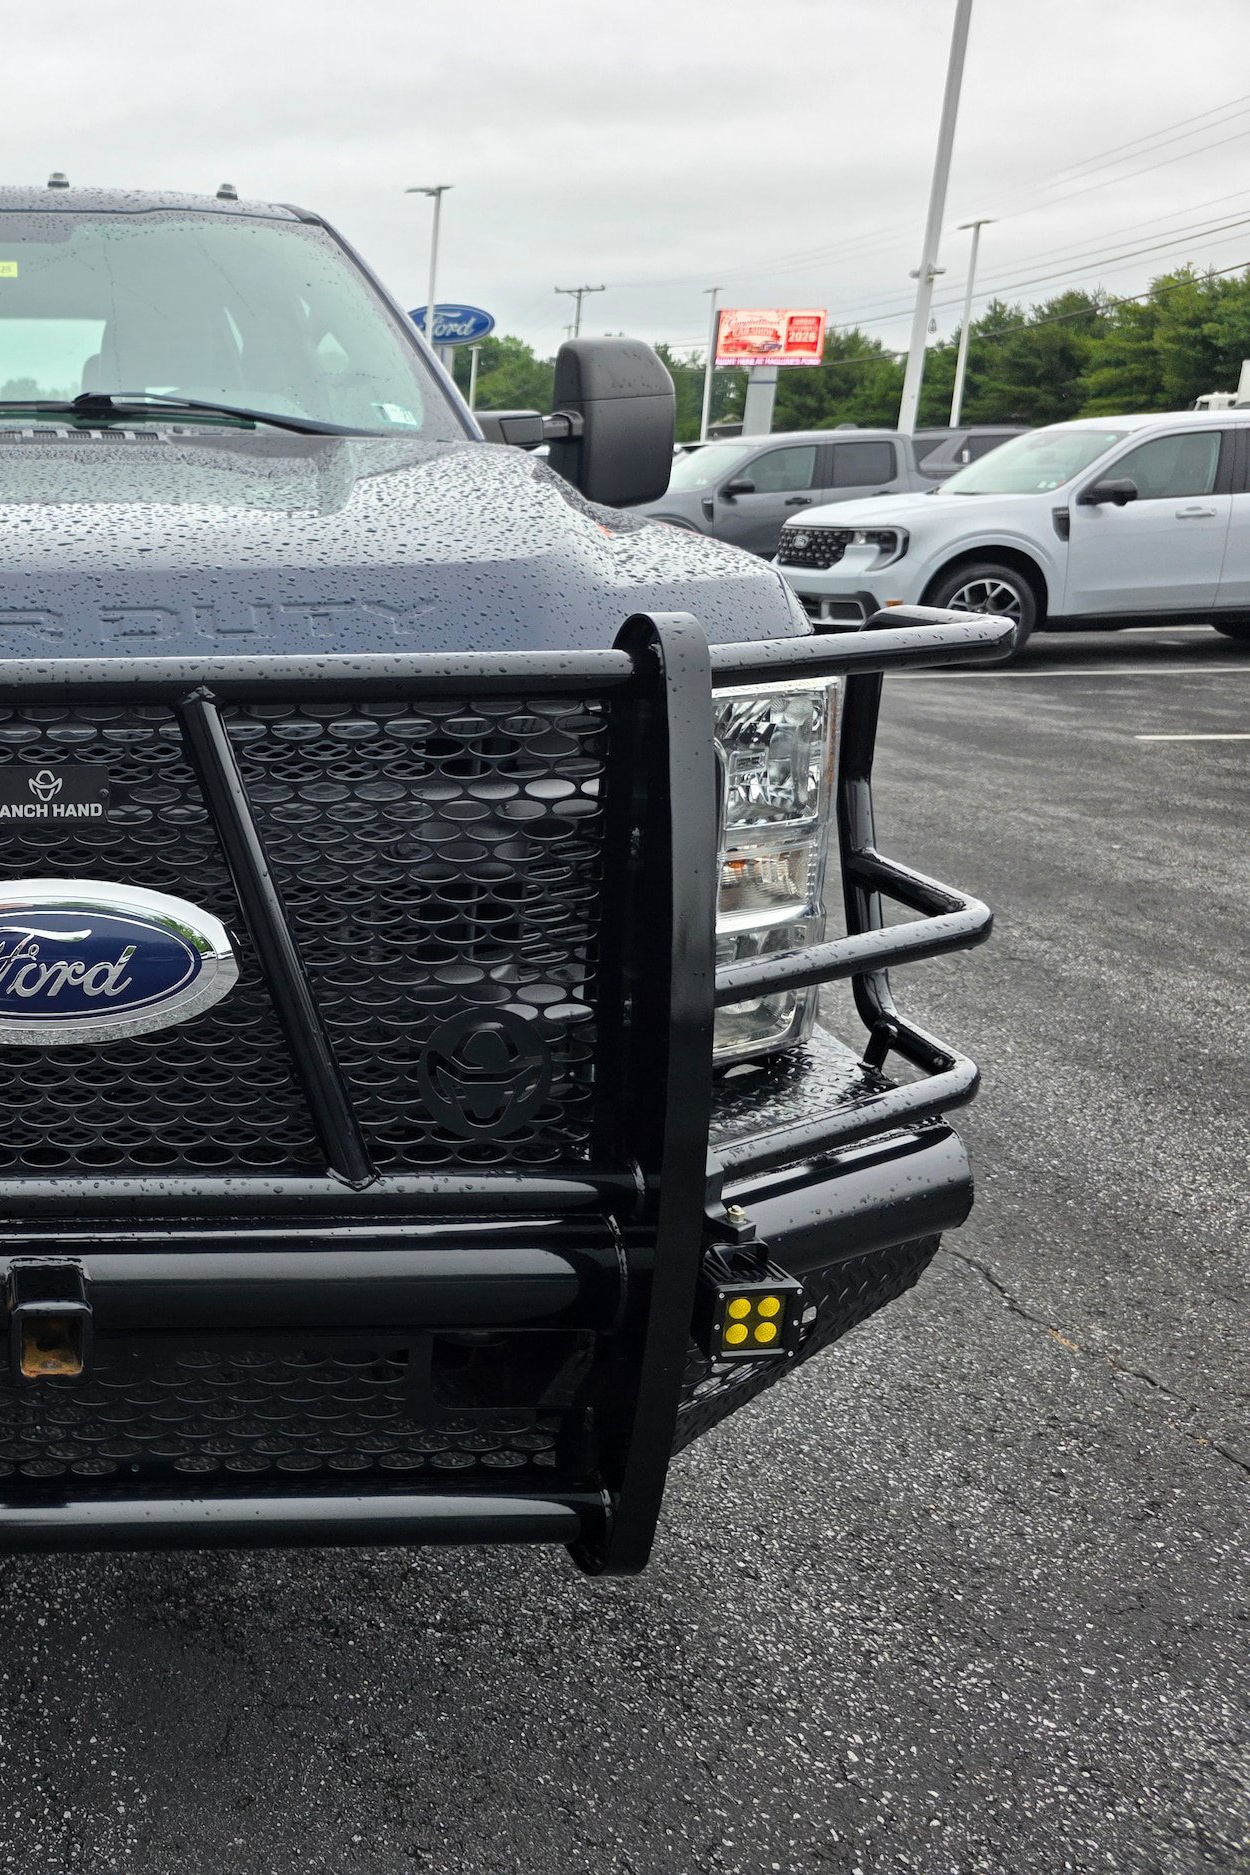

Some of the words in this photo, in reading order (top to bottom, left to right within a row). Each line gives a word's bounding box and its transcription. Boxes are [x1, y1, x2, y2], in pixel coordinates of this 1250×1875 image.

[788, 332, 816, 343] 2026
[98, 600, 438, 643] DUTY
[52, 803, 103, 817] HAND
